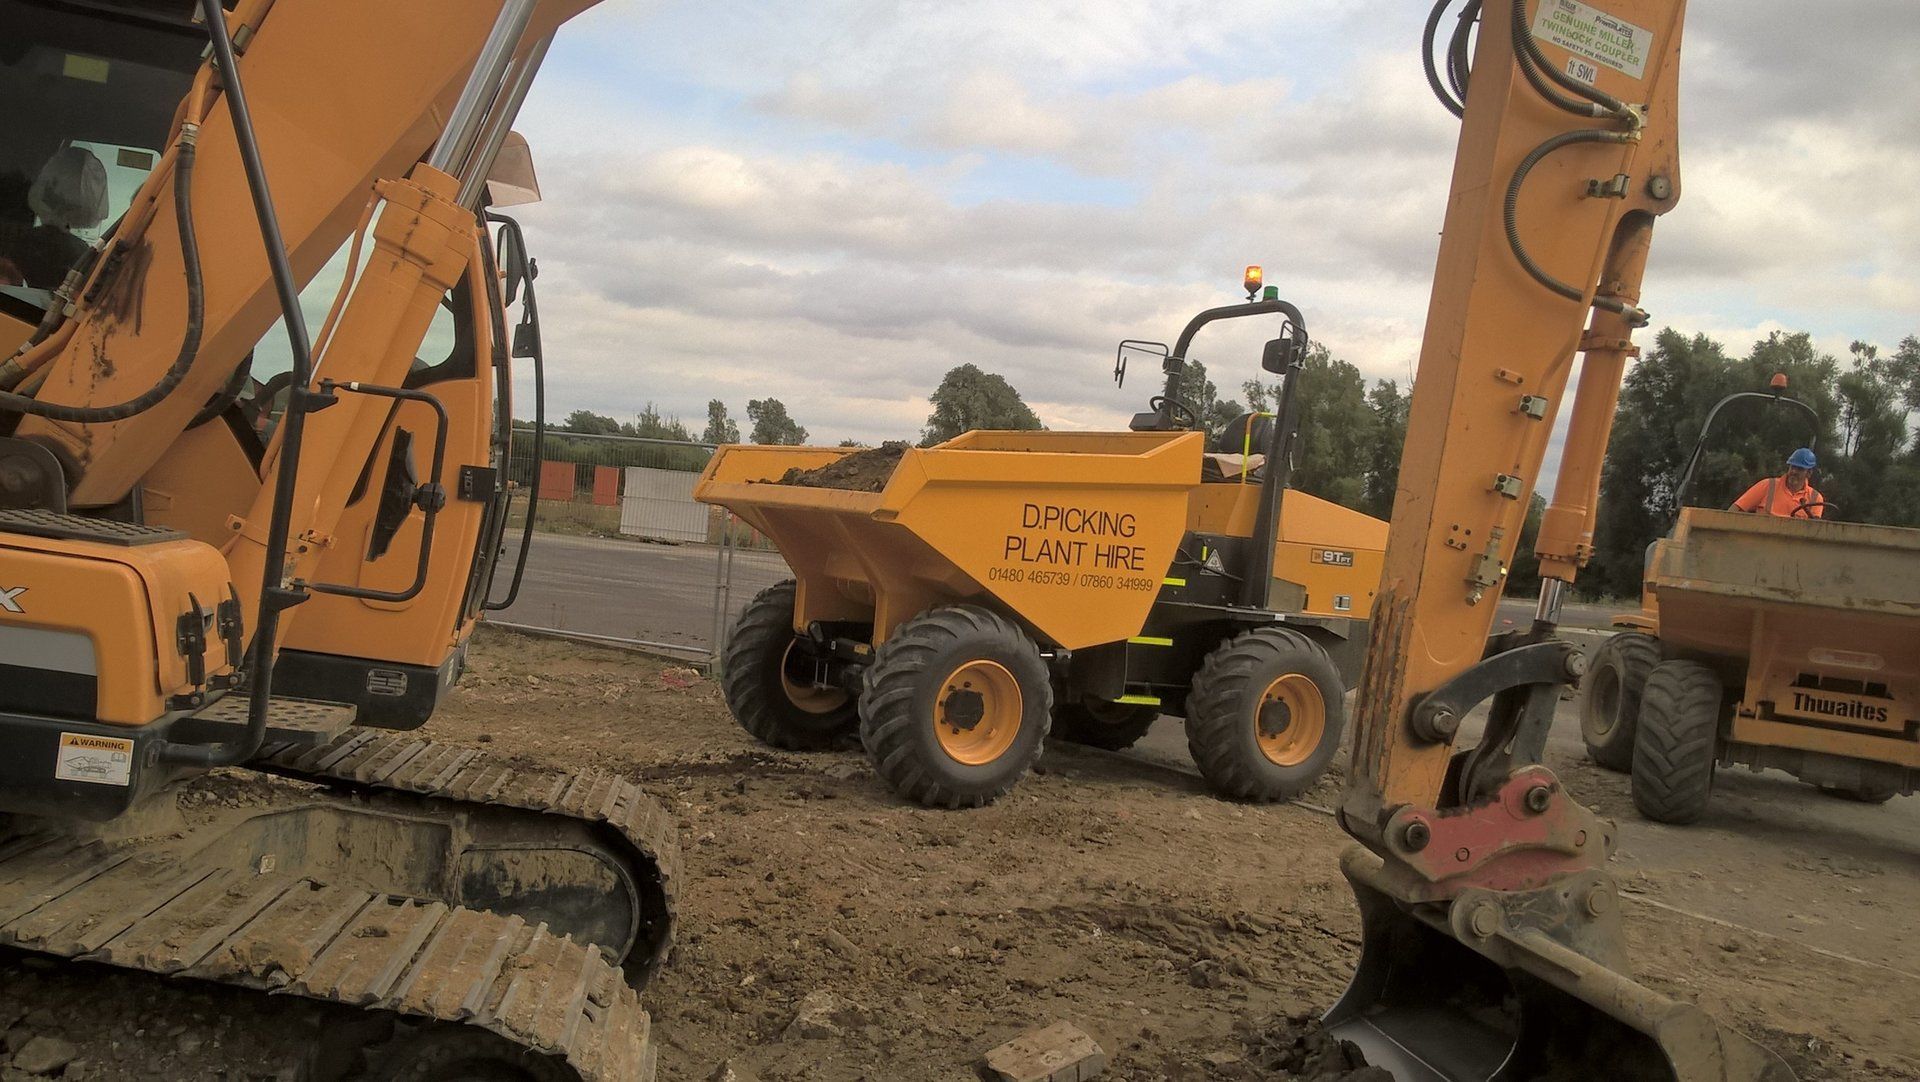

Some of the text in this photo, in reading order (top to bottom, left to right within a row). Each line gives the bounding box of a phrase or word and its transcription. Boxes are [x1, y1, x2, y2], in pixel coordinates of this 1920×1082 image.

[1542, 18, 1640, 66] TWINLOCK COUPLER
[1552, 10, 1634, 52] GENUINE MILLER
[1562, 40, 1584, 52] SAFETY
[1594, 53, 1623, 69] REQUIRED
[1576, 63, 1594, 83] SWL
[1022, 503, 1136, 538] D.PICKING
[1004, 535, 1146, 571] PLANT HIRE
[988, 567, 1024, 583] 01480
[1027, 571, 1071, 586] 465739
[1080, 574, 1114, 589] 07860
[1116, 577, 1154, 592] 341999
[1793, 692, 1888, 723] Thwaites
[80, 738, 125, 750] WARNING
